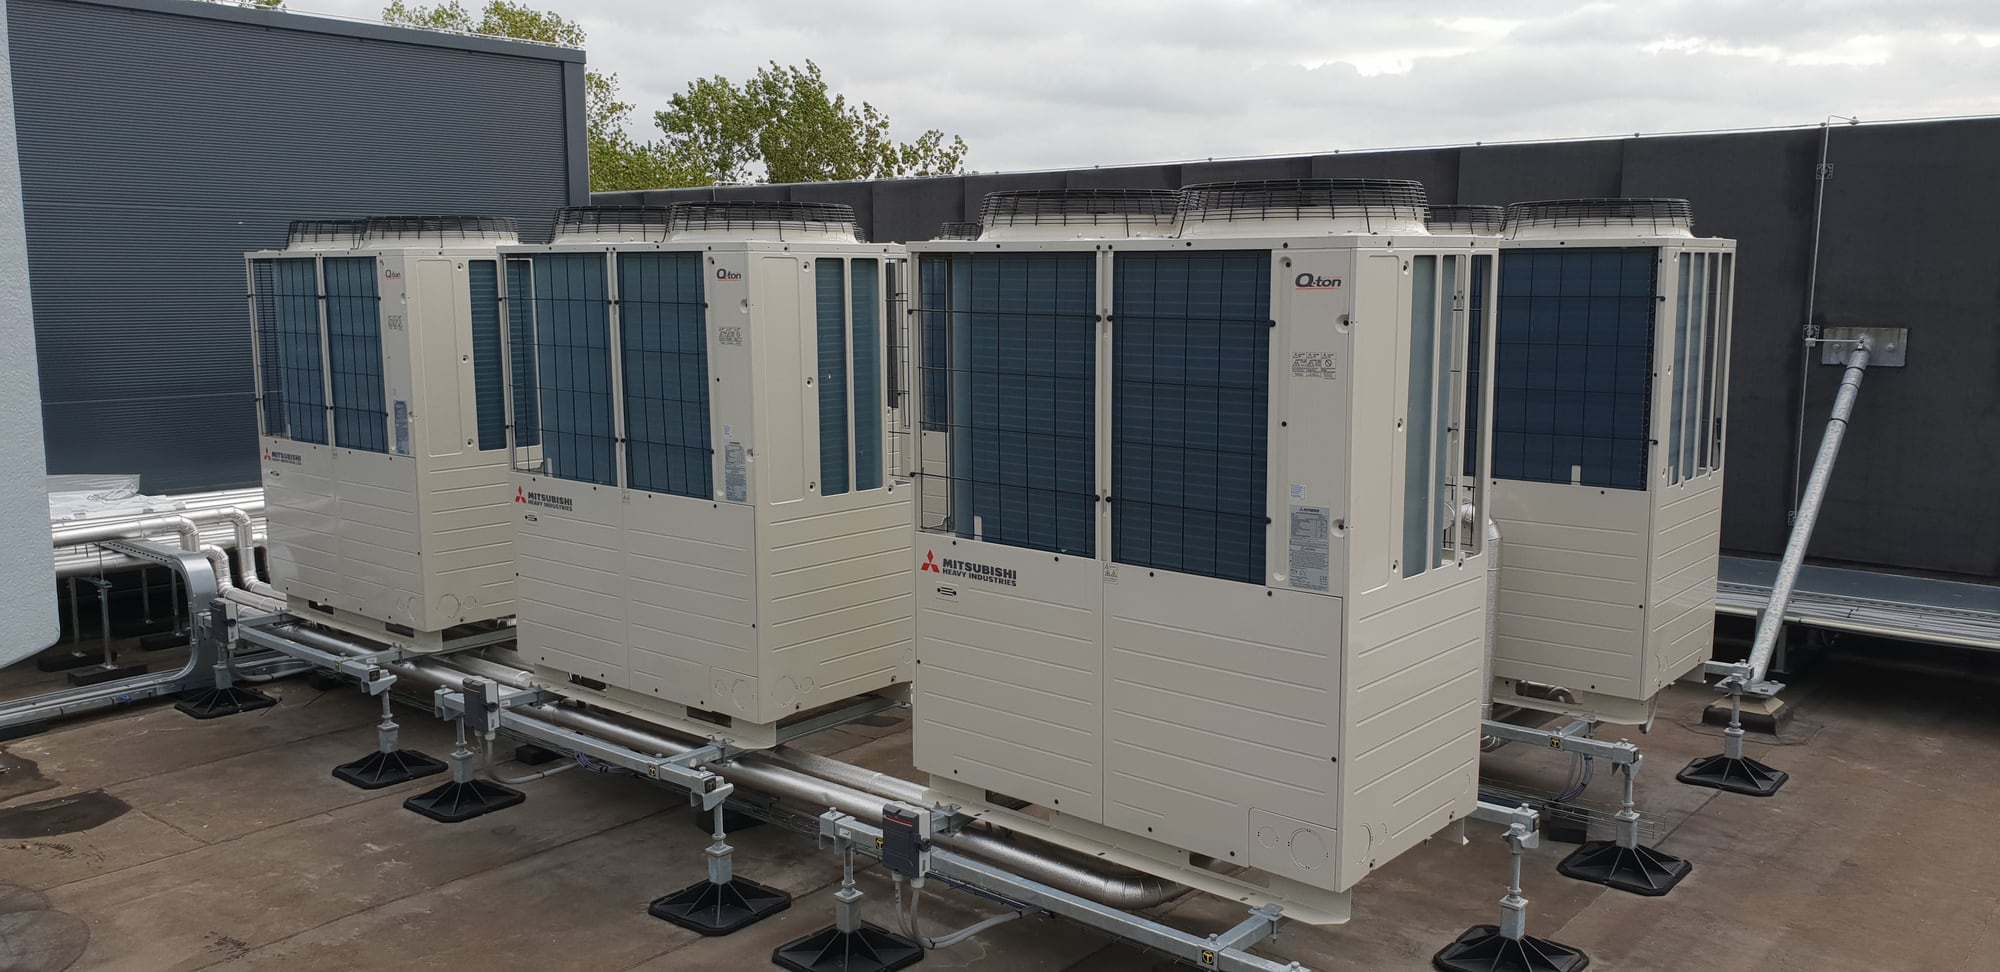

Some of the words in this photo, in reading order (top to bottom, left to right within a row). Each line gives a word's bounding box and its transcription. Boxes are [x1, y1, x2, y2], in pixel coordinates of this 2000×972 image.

[527, 491, 573, 505] MITSUBISHI
[942, 558, 1017, 580] MITSUBISHI
[942, 568, 967, 577] HEAVY
[968, 572, 1017, 587] INDUSTRIES
